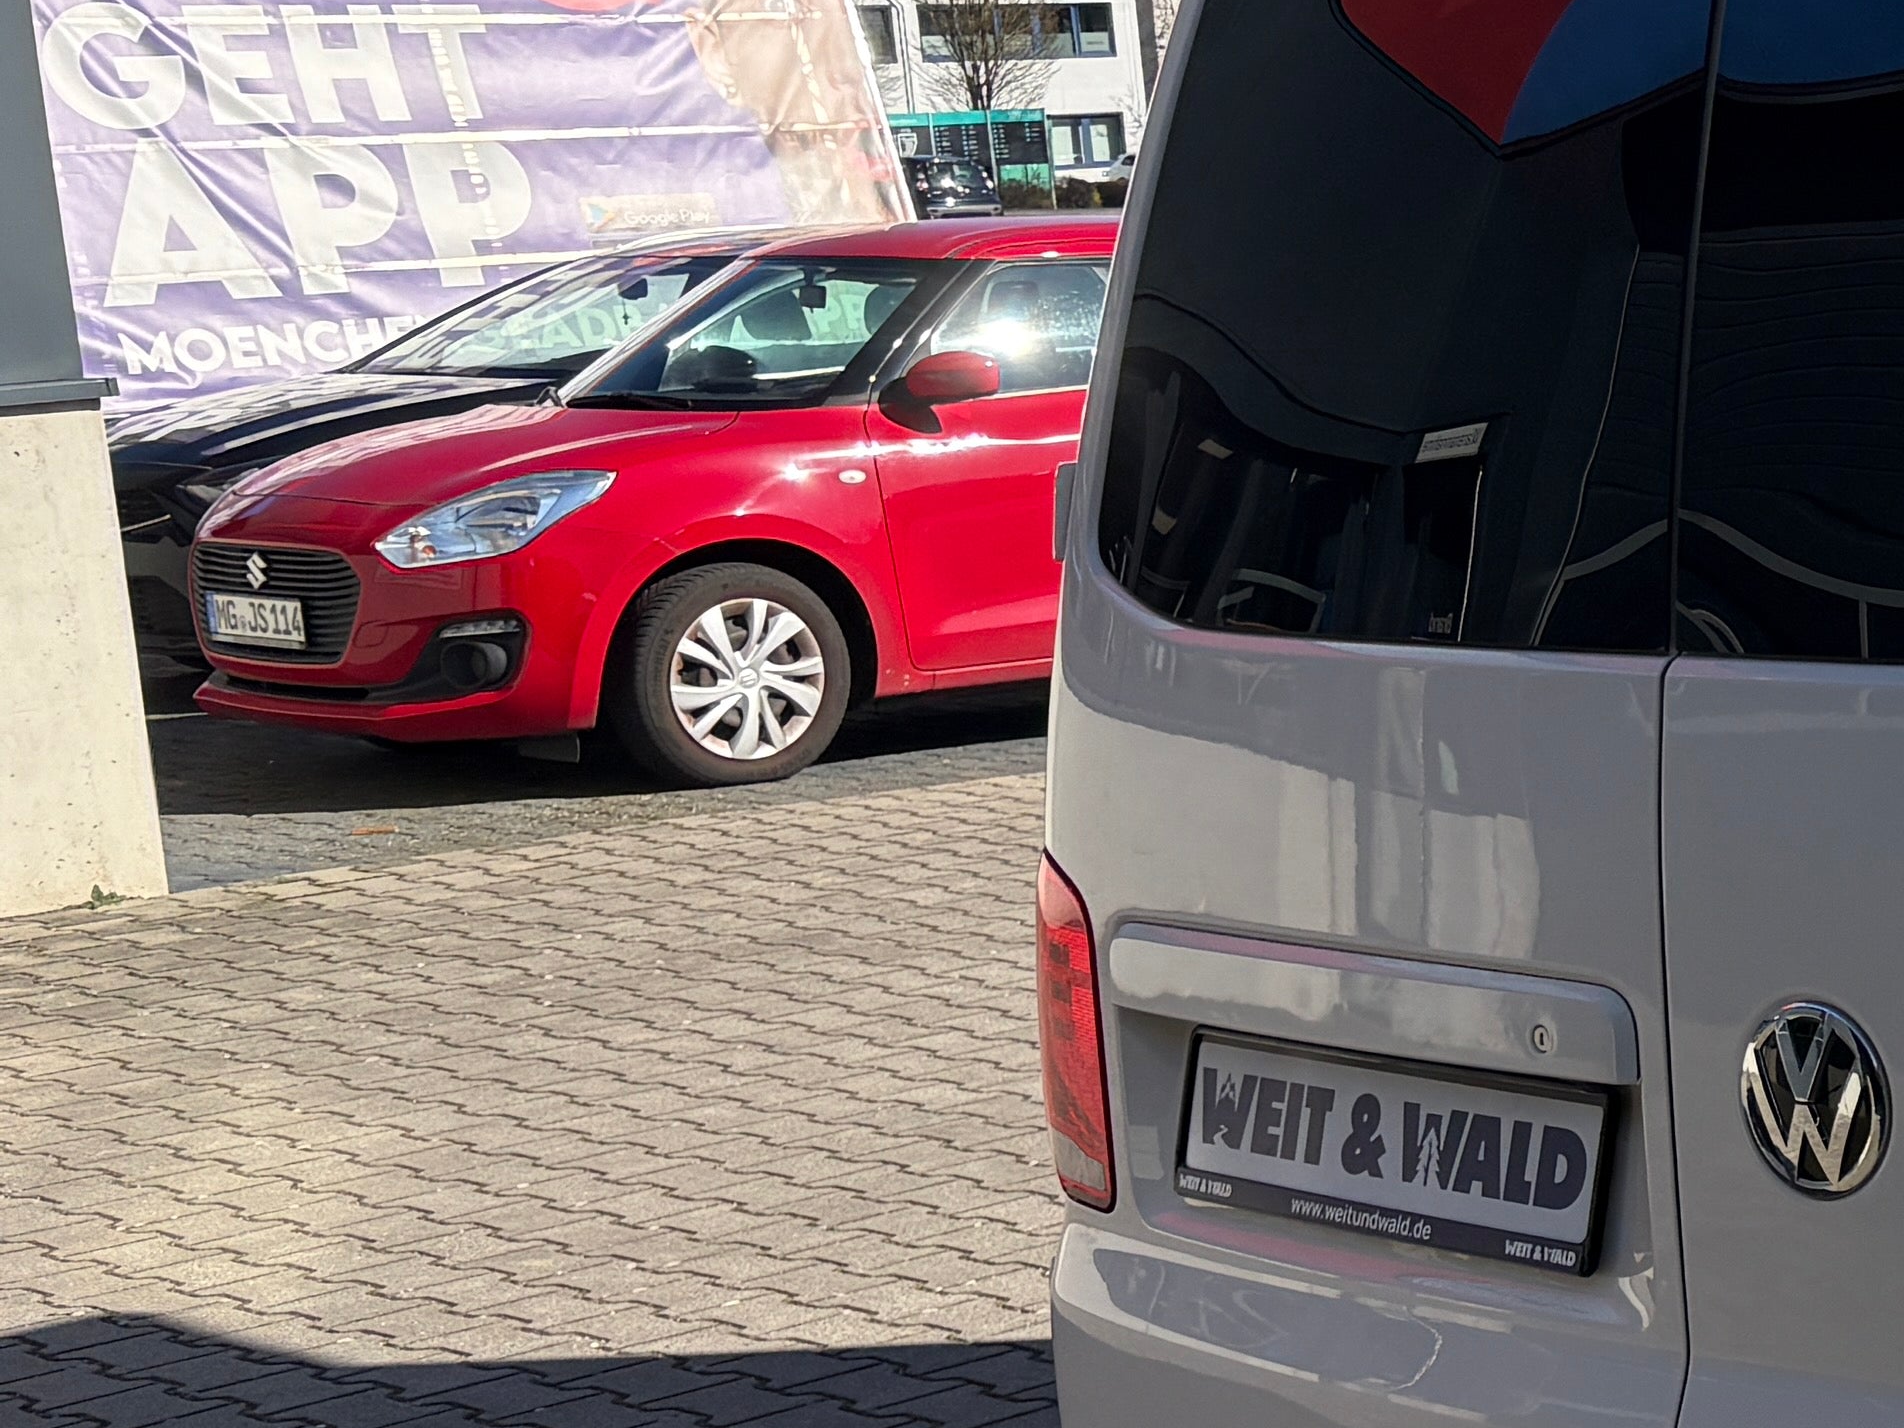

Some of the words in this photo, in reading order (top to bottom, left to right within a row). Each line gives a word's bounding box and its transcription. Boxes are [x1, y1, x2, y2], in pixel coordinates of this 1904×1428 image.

[42, 2, 488, 130] GEHT
[104, 137, 533, 308] APP
[624, 211, 677, 226] Google
[679, 209, 710, 224] Play
[215, 599, 239, 631] MG
[1202, 1067, 1335, 1166] WEIT
[1341, 1092, 1384, 1178] &
[1401, 1101, 1589, 1211] WALD
[1291, 1197, 1433, 1241] www.weitundwald.de
